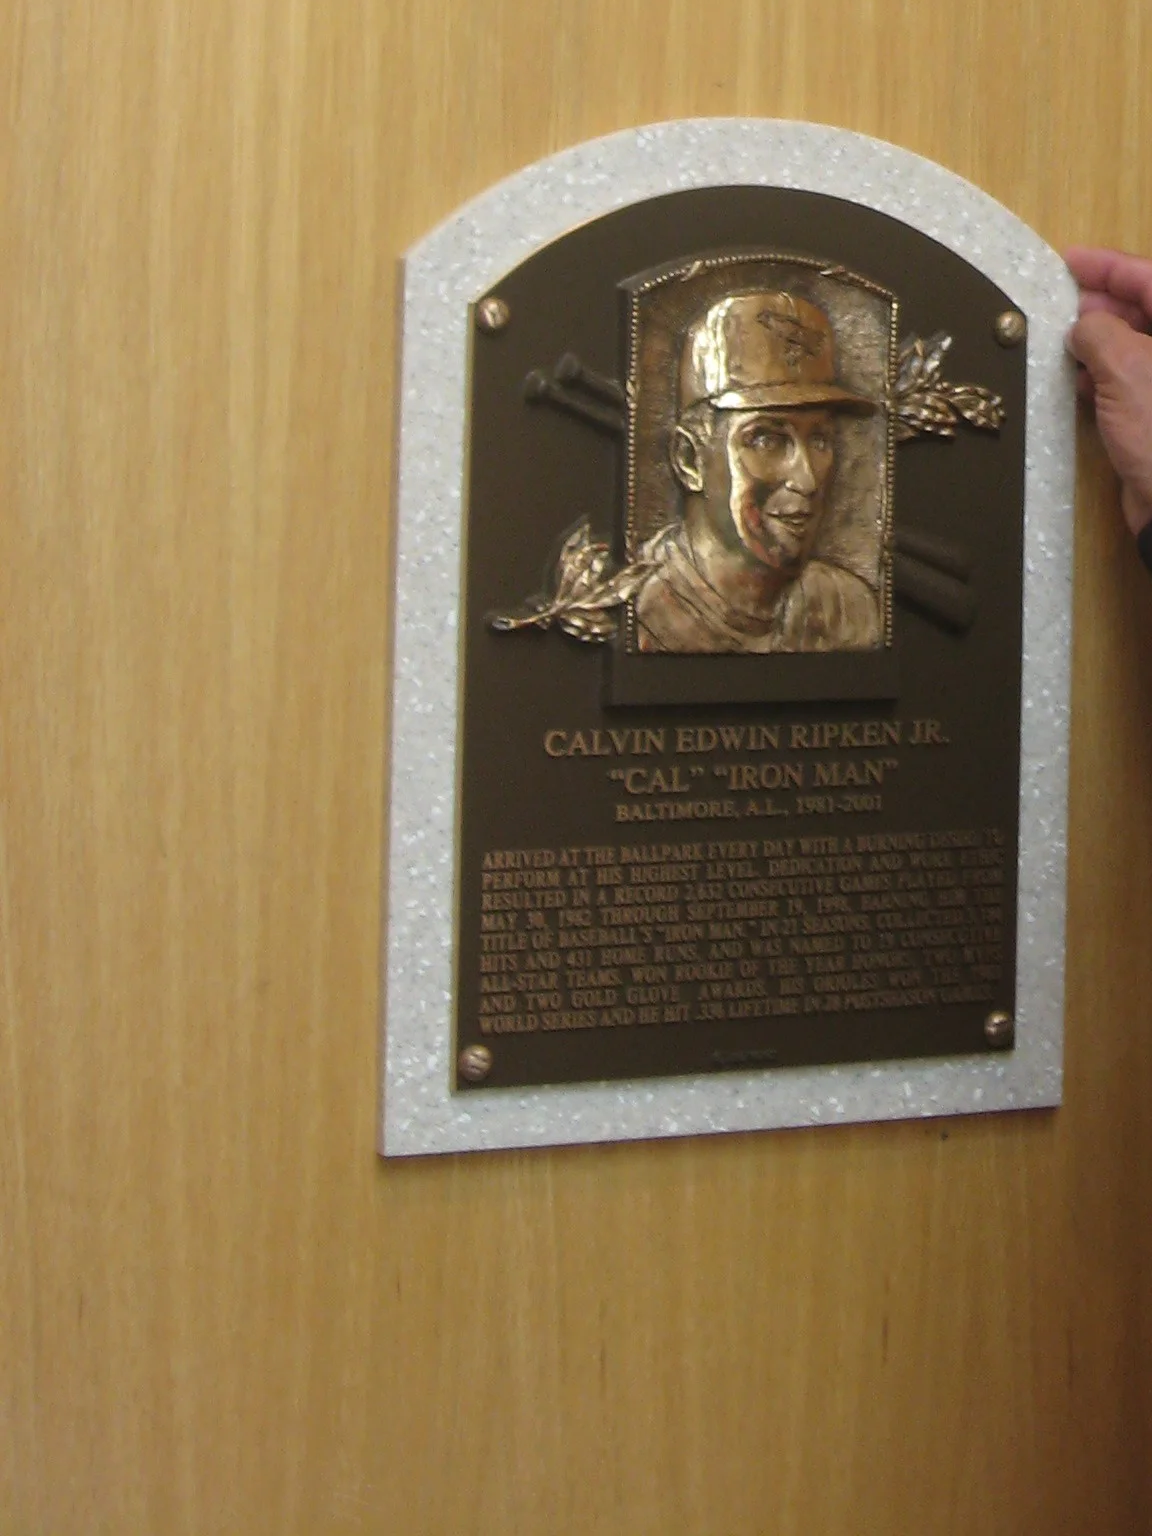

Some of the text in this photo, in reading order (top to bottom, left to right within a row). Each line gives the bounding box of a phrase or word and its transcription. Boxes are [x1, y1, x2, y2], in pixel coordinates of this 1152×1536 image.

[542, 726, 666, 756] CALVIN
[674, 723, 779, 752] EDWIN
[789, 719, 901, 748] RIPKEN
[795, 794, 883, 814] 1981-2001
